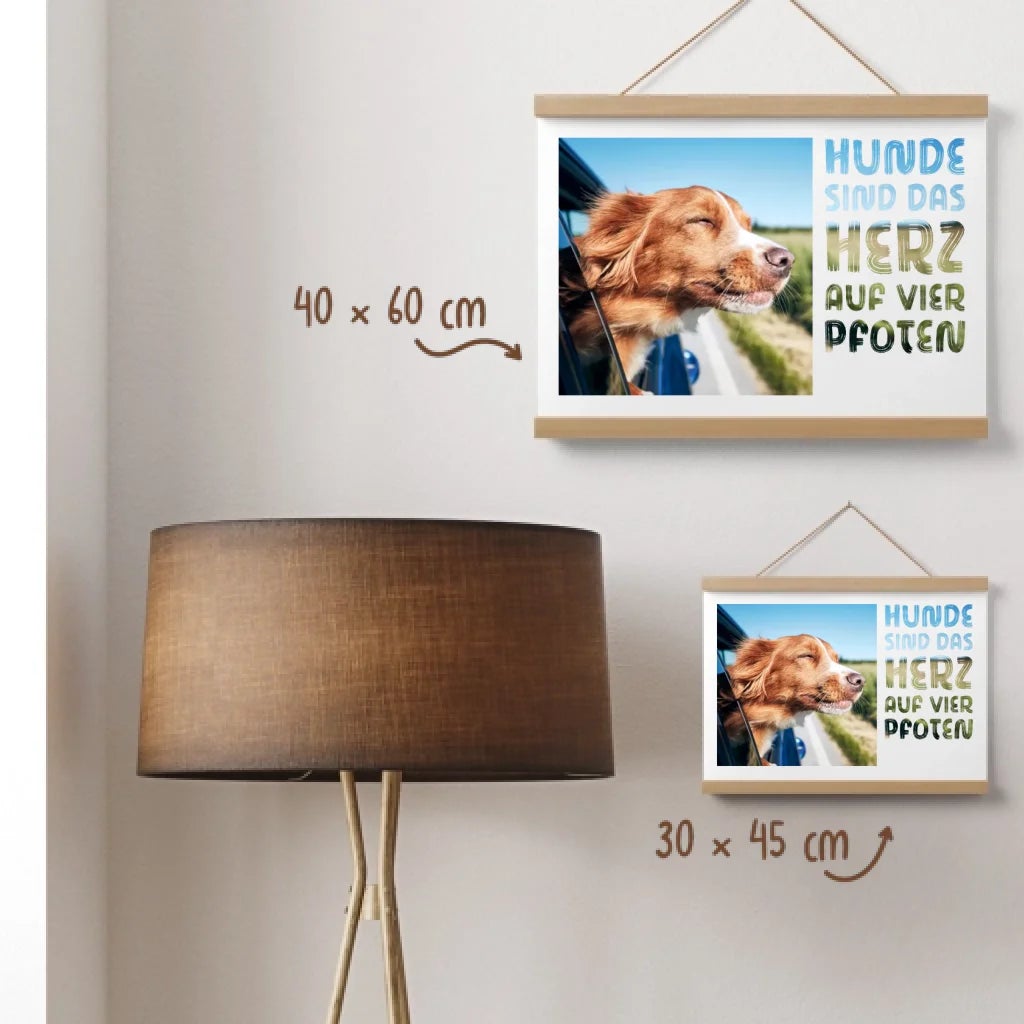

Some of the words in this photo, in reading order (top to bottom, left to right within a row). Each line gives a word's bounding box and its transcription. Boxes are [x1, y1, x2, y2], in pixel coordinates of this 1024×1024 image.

[825, 137, 965, 175] HUNDE
[824, 183, 897, 212] SIND
[907, 183, 965, 211] DAS
[825, 219, 965, 275] HERZ
[825, 283, 886, 311] AUF
[896, 283, 965, 312] VIER
[824, 319, 966, 354] PFOTEN
[884, 604, 973, 628] HUNDE
[884, 633, 930, 650] SIND
[936, 632, 974, 651] DAS
[884, 656, 974, 690] HERZ
[884, 695, 923, 713] AUF
[929, 695, 974, 714] VIER
[884, 718, 974, 740] PFOTEN
